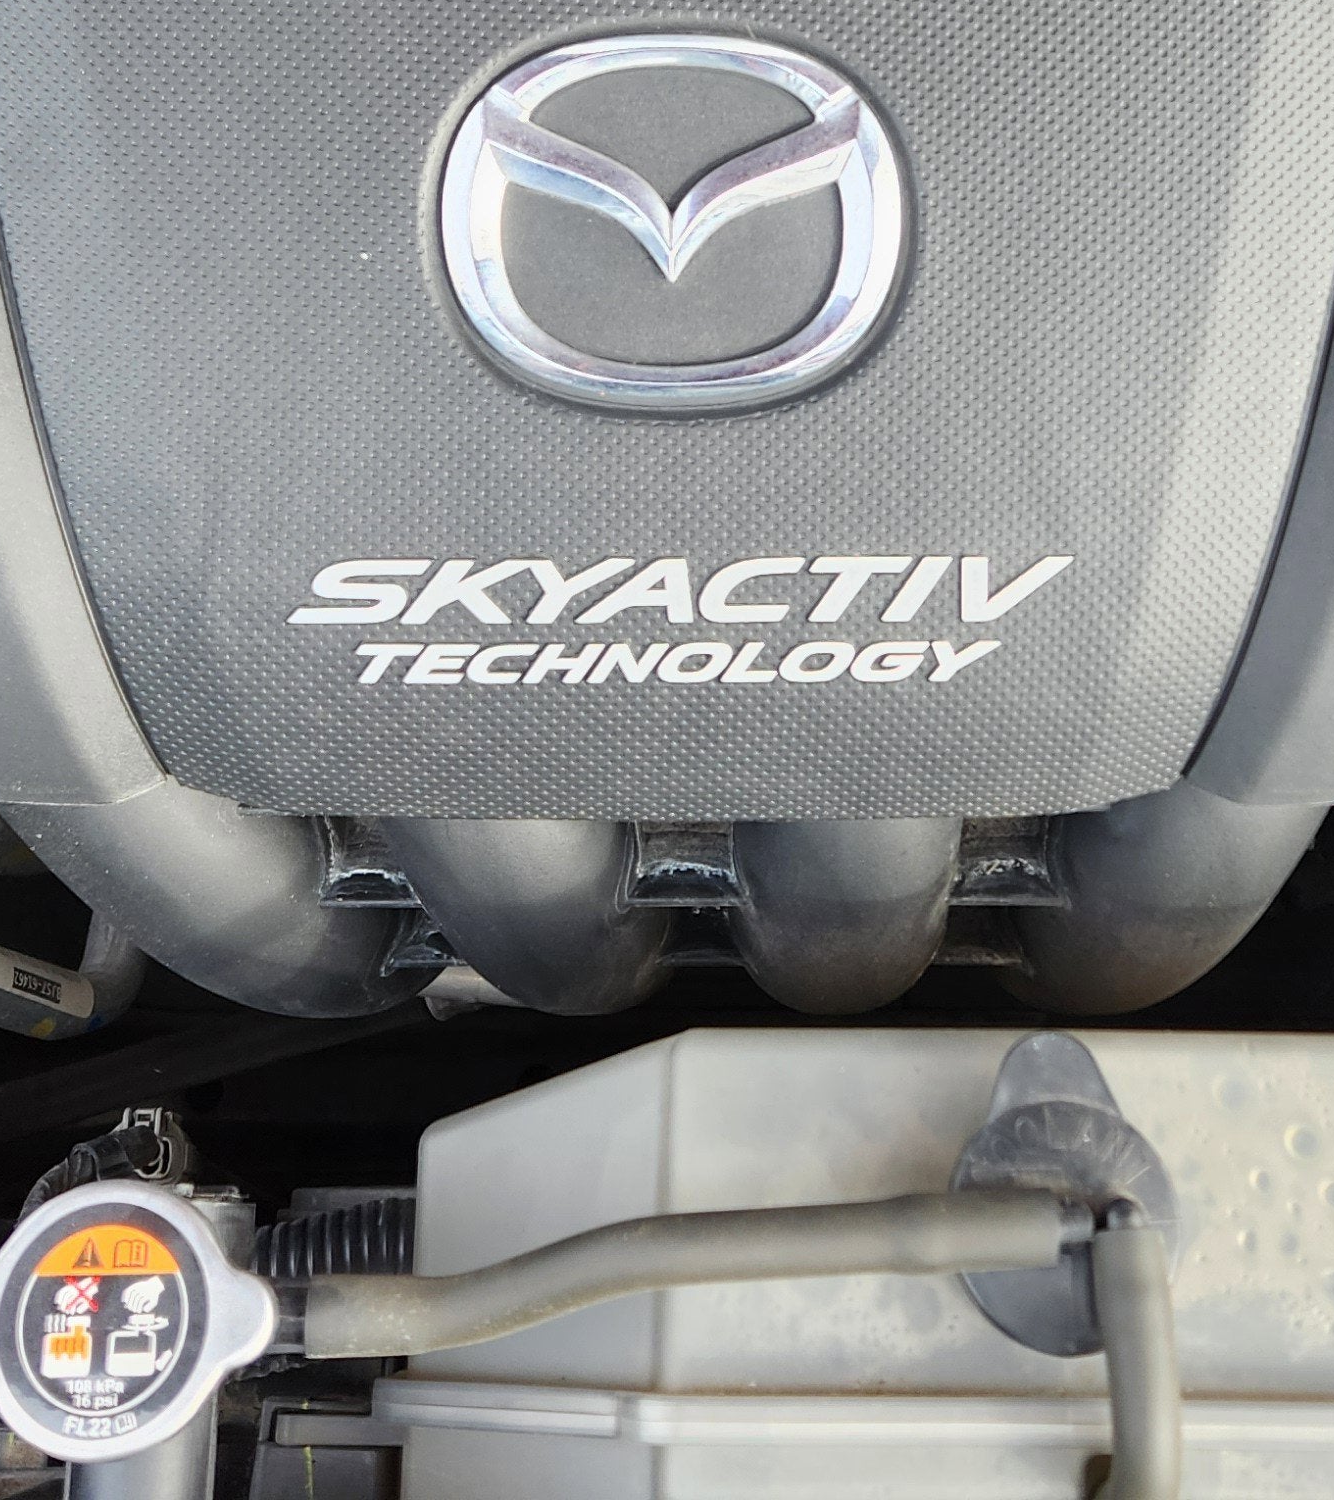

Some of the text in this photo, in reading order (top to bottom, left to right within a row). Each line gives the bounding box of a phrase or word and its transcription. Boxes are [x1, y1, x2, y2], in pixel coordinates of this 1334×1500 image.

[286, 556, 1074, 625] SKYACTIV
[355, 640, 1002, 685] TECHNOLOGY
[95, 1379, 124, 1394] kPa
[94, 1393, 118, 1409] psi
[64, 1415, 112, 1438] FL22
